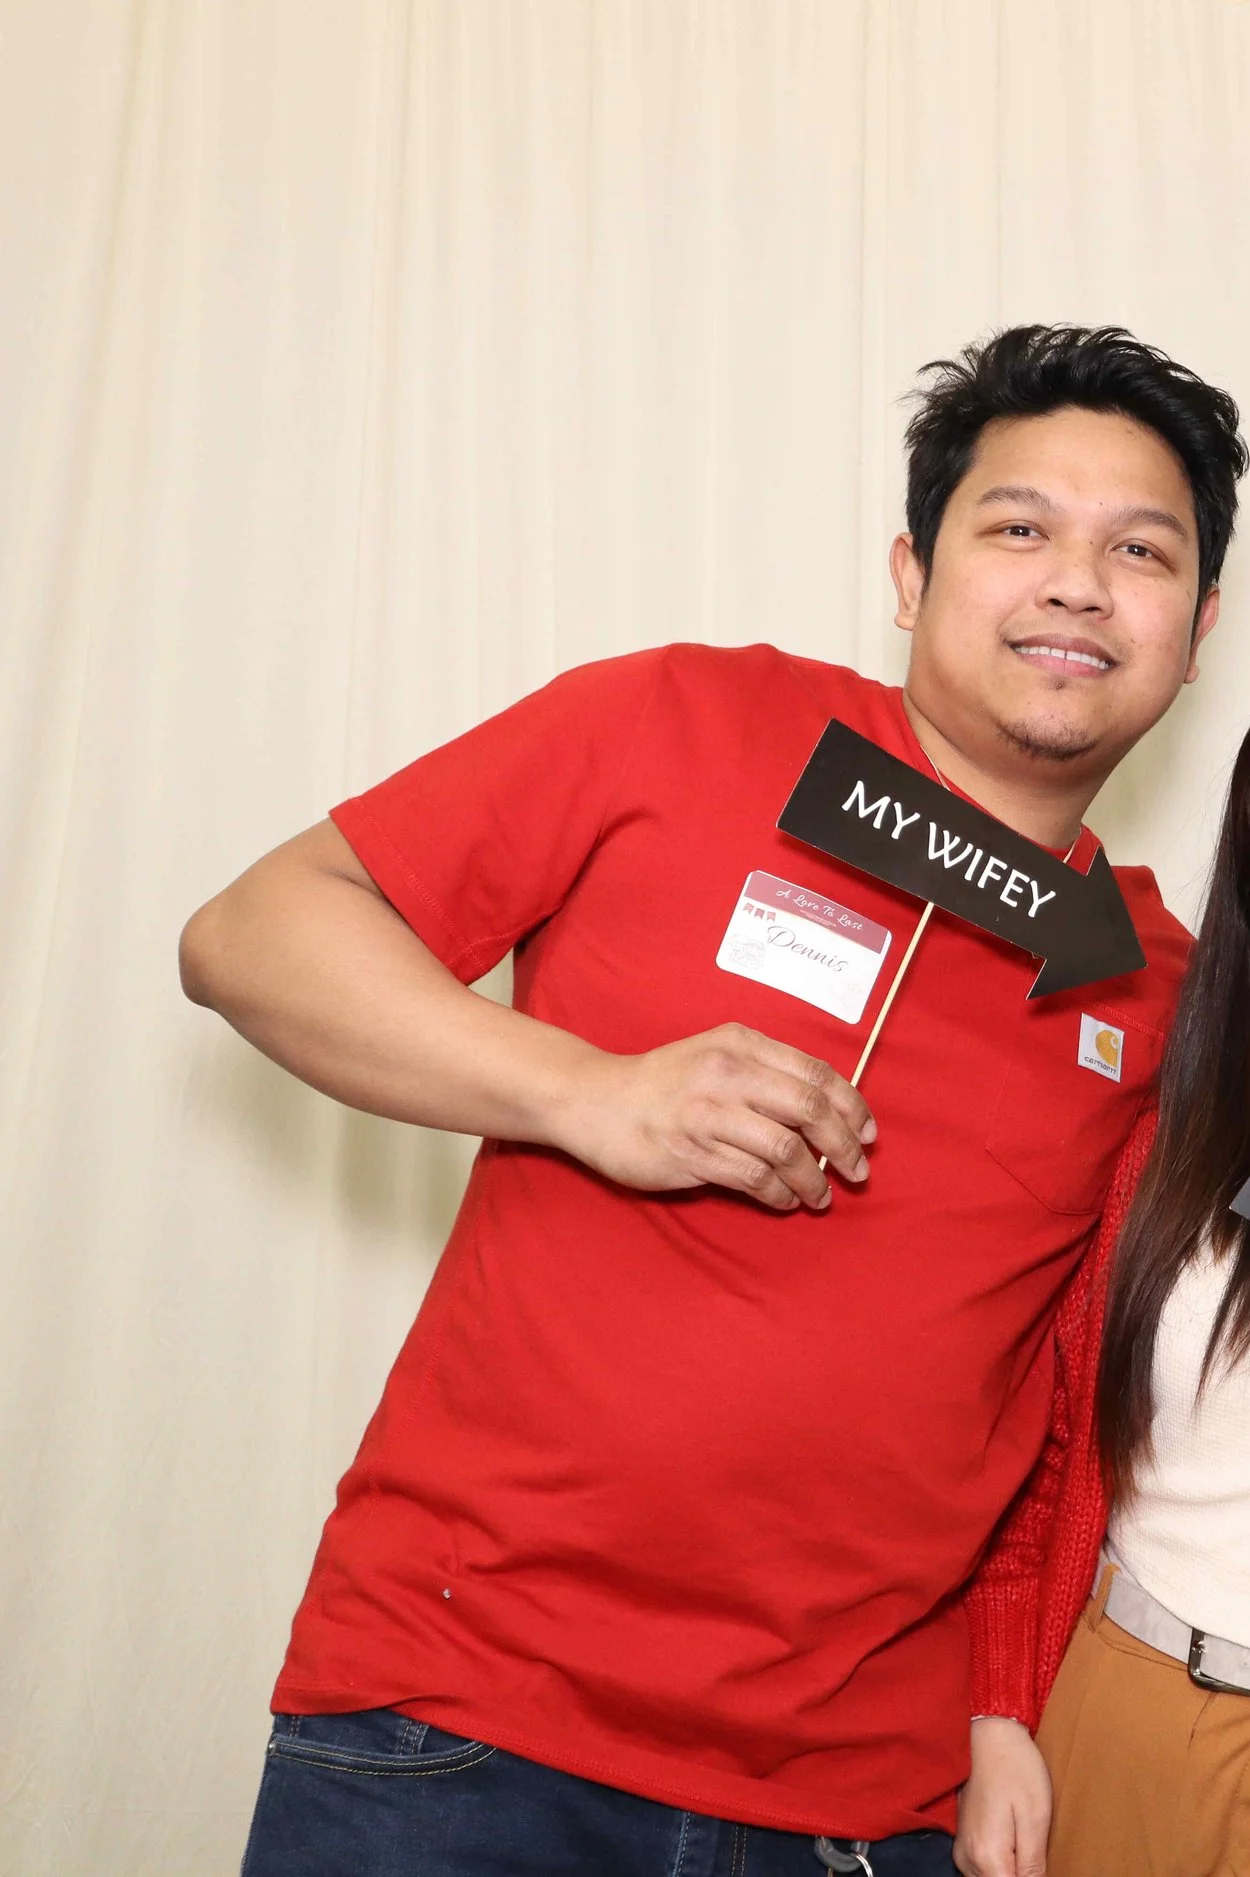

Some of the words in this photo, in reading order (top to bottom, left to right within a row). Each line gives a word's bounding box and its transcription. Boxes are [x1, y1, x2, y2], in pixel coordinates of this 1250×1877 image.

[841, 779, 921, 841] MY
[926, 821, 1057, 919] WIFEY
[775, 889, 792, 898] A
[793, 894, 819, 911] Love
[822, 905, 836, 917] To
[837, 914, 864, 931] Last
[766, 925, 849, 973] Dennis
[1084, 1056, 1117, 1075] carhartt
